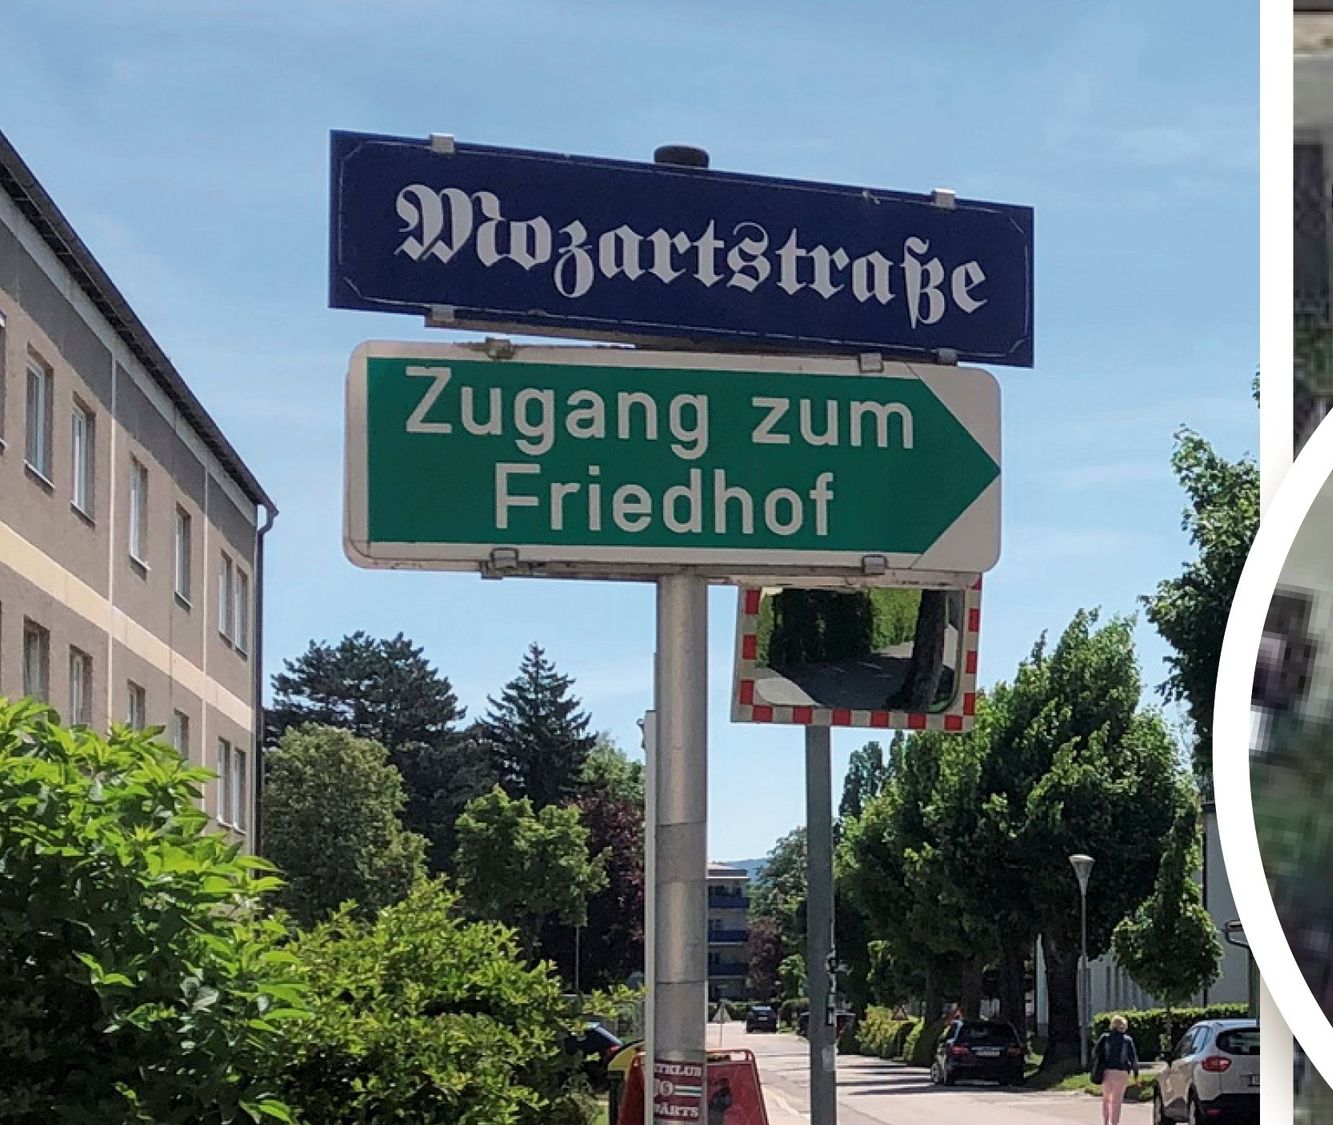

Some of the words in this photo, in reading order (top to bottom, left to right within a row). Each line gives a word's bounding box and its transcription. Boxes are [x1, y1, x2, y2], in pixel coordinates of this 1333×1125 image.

[393, 182, 988, 329] Mozartstraße
[404, 365, 711, 460] Zugang
[751, 396, 915, 450] zum
[493, 463, 835, 537] Friedhof
